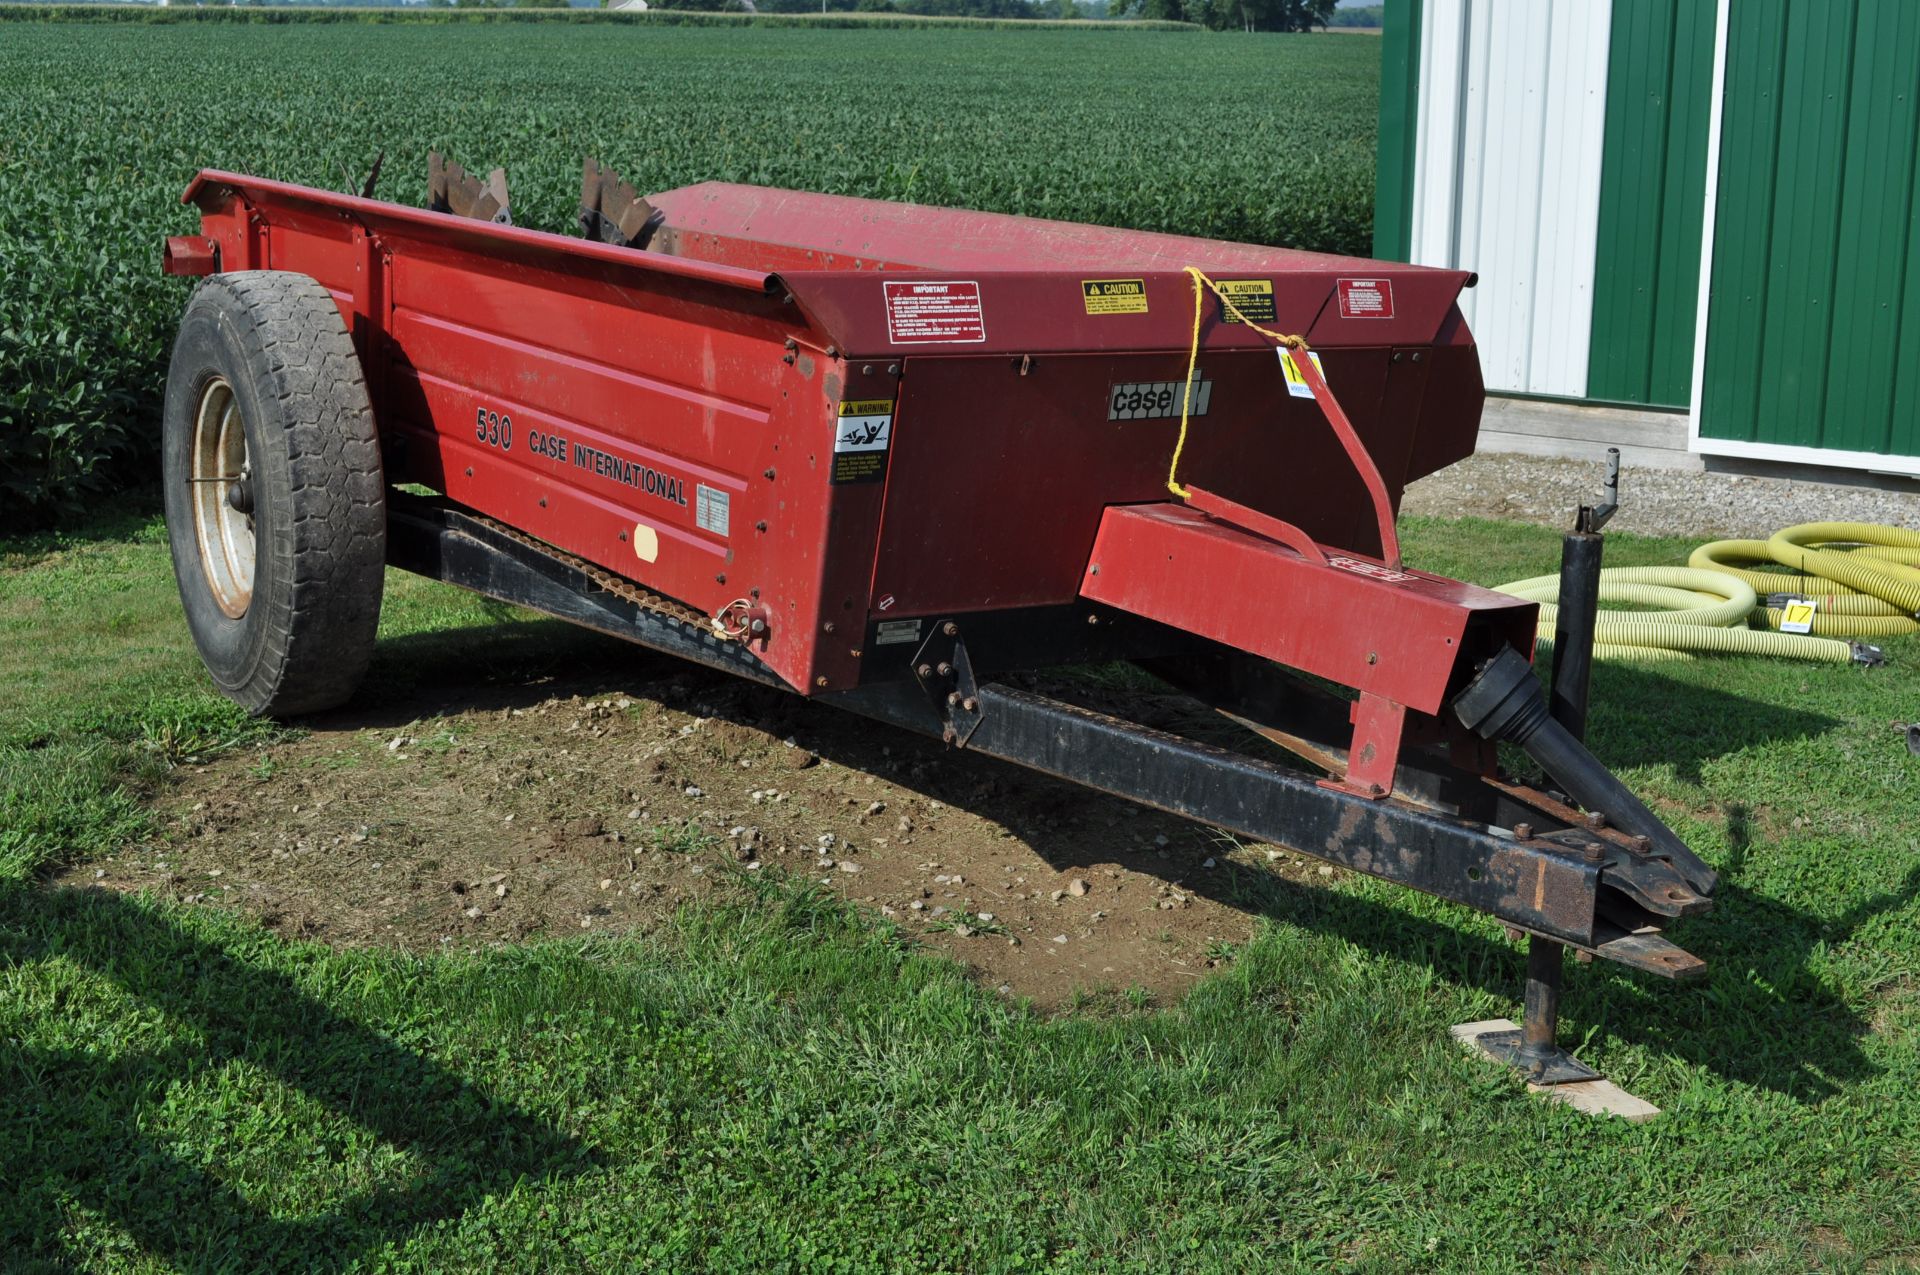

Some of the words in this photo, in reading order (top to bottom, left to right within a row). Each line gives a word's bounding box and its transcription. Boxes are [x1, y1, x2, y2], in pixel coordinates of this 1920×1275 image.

[913, 286, 949, 294] IMPORTANT
[1103, 283, 1139, 295] CAUTION
[1234, 284, 1264, 293] CAUTION
[1112, 386, 1173, 415] case
[857, 403, 889, 414] WARNING
[476, 407, 512, 451] 530
[529, 429, 567, 462] CASE
[574, 443, 688, 507] INTERNATIONAL
[1788, 605, 1812, 622] 17
